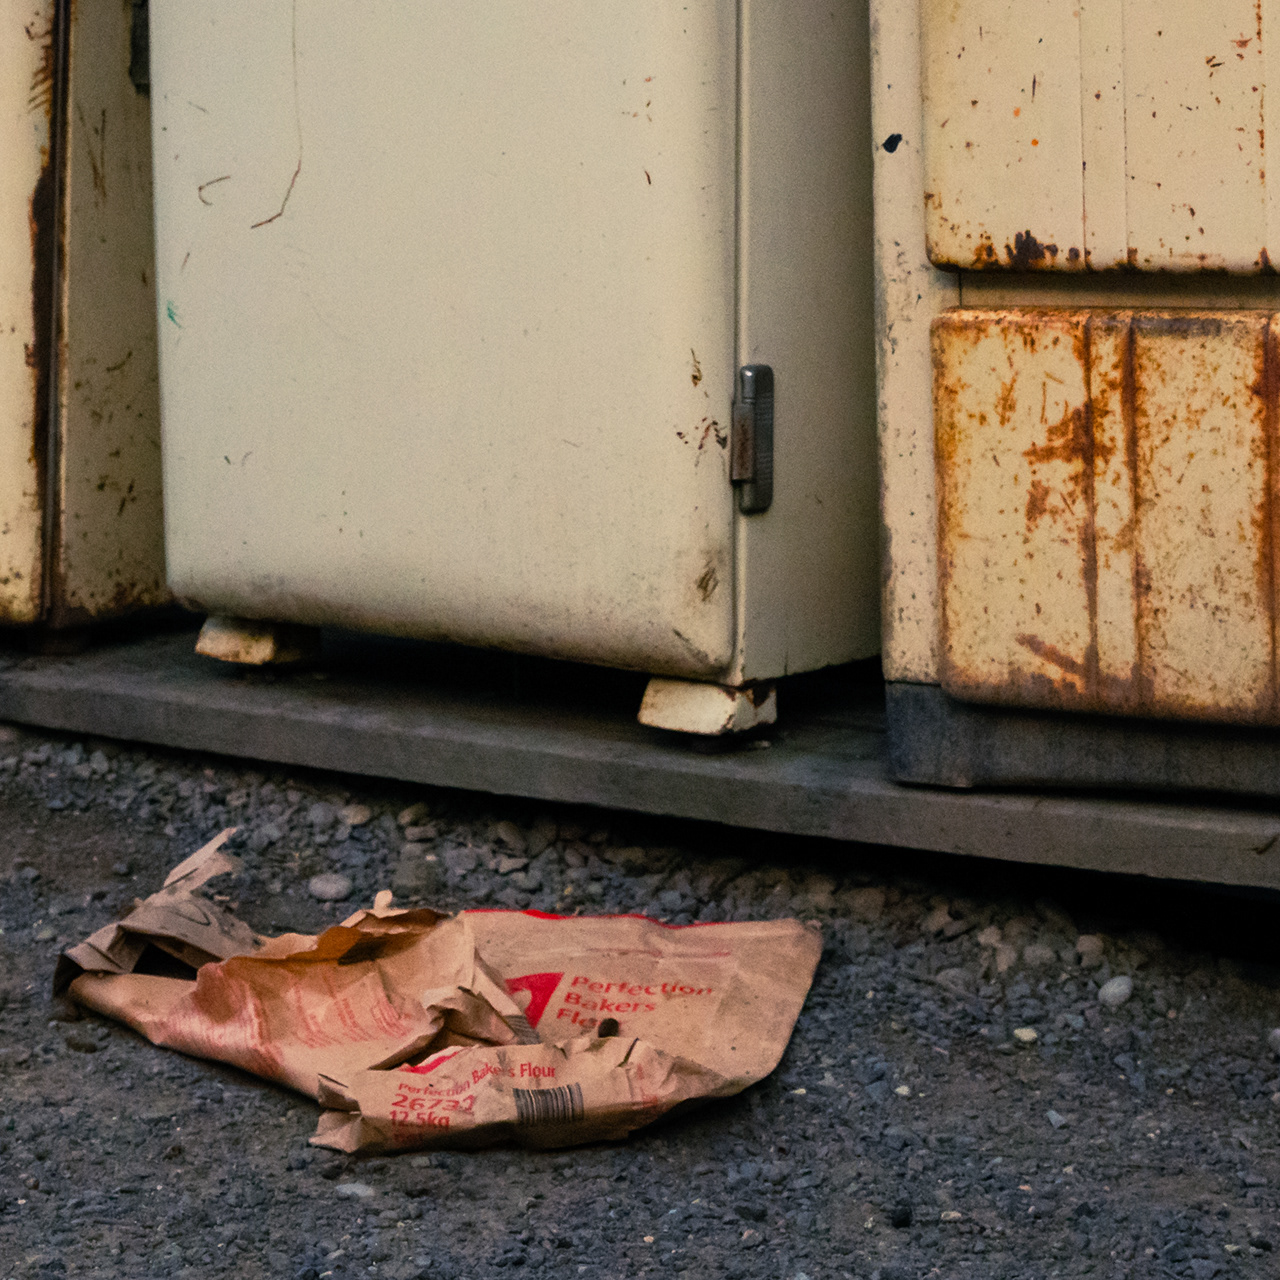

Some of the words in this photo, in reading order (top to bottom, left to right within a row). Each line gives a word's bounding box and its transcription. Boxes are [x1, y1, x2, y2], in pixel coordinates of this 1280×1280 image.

[571, 975, 714, 996] Perfection
[564, 991, 657, 1013] Bakers
[556, 1007, 606, 1029] Flo
[472, 1062, 515, 1084] Bakes
[520, 1062, 556, 1078] Flour
